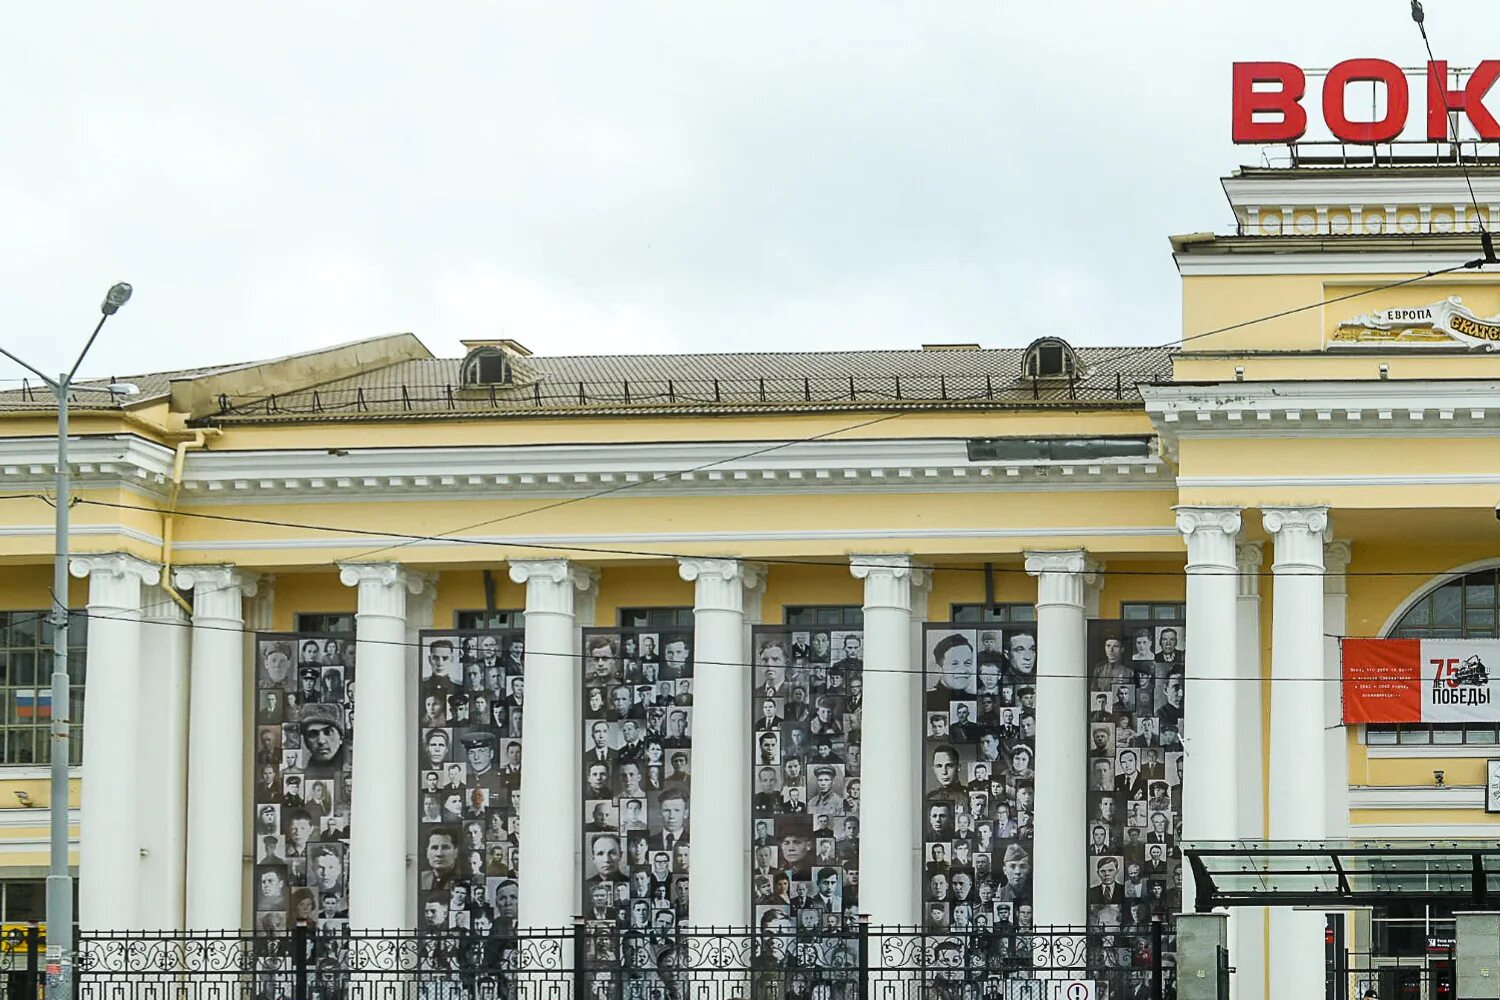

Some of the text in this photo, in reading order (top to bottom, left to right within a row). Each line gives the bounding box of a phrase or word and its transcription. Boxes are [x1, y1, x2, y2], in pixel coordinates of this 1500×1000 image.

[1387, 308, 1433, 321] ЕВРОПА
[1430, 658, 1460, 689] 75
[1432, 688, 1490, 706] ПОБЕДЫ
